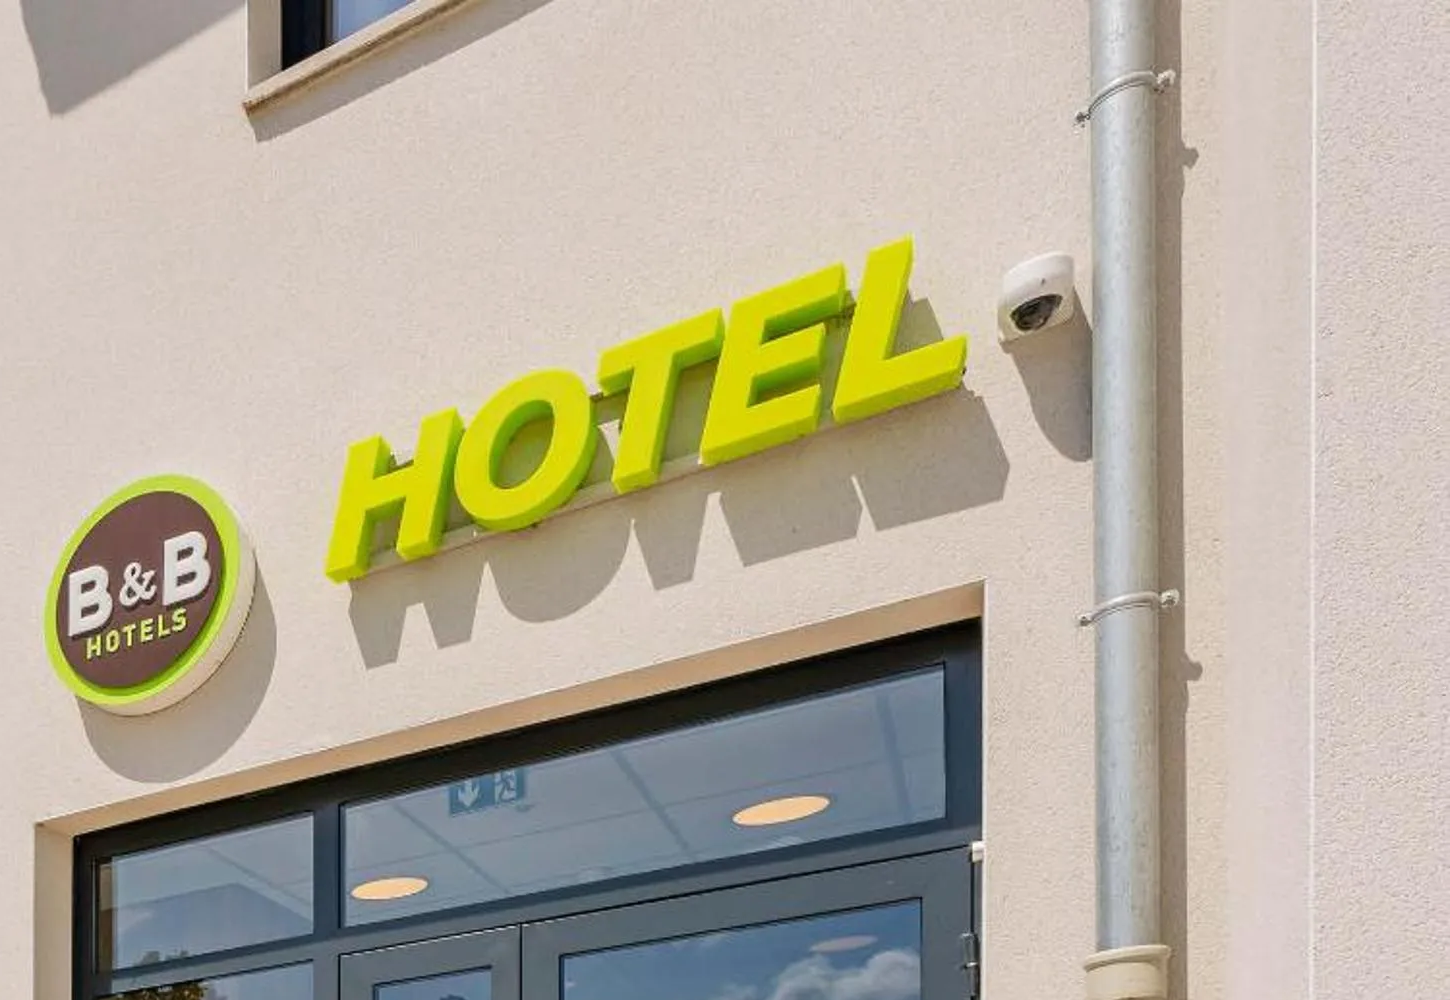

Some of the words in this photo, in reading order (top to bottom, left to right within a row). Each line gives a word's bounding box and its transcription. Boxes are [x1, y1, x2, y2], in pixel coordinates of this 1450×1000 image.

[325, 234, 967, 583] HOTEL
[67, 530, 212, 637] B&B
[85, 607, 188, 660] HOTELS
